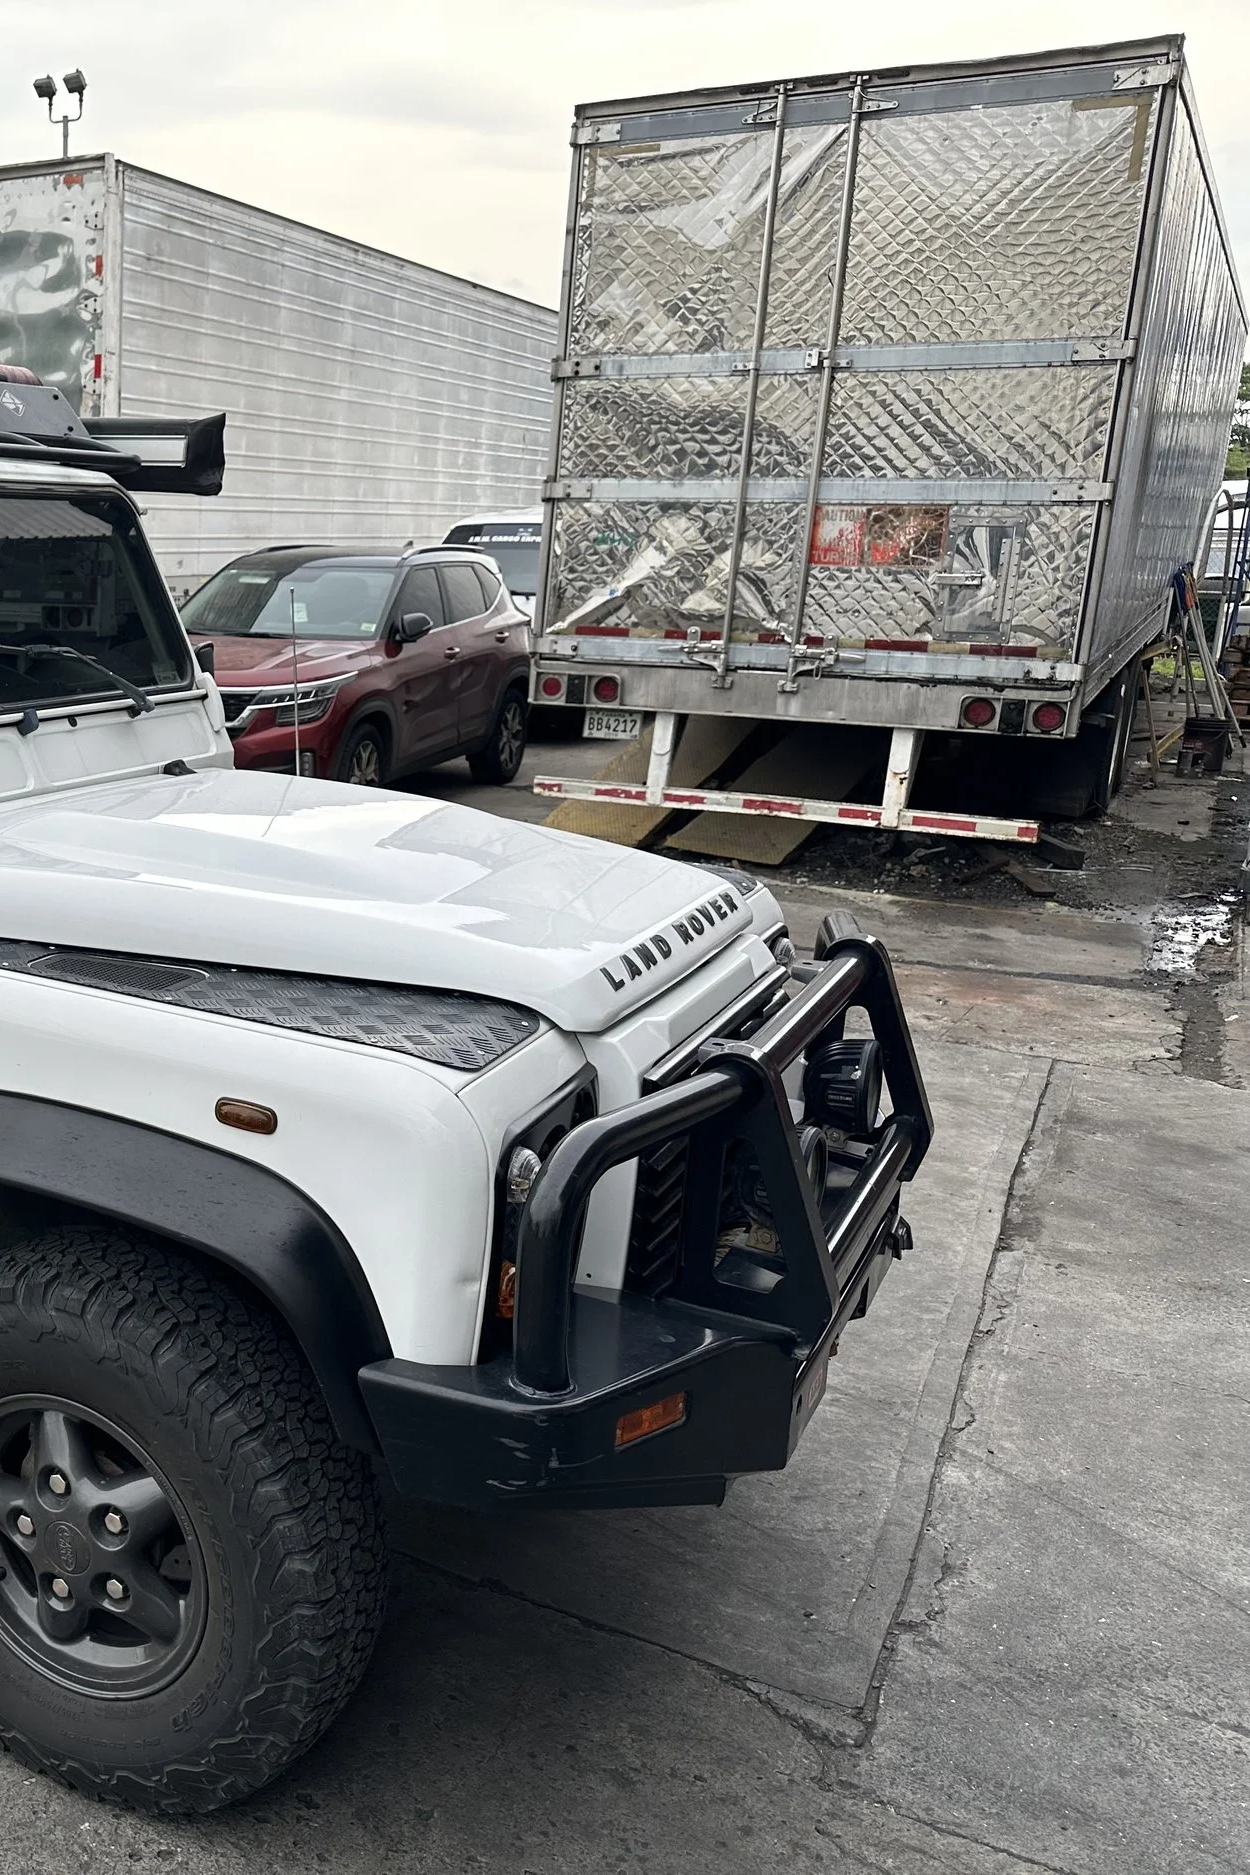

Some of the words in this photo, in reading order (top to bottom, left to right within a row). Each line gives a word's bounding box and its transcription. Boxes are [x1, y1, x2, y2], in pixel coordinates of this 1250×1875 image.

[491, 535, 520, 543] CARGO
[588, 716, 638, 733] BB4217
[599, 934, 672, 992] LAND
[671, 891, 738, 945] ROVER
